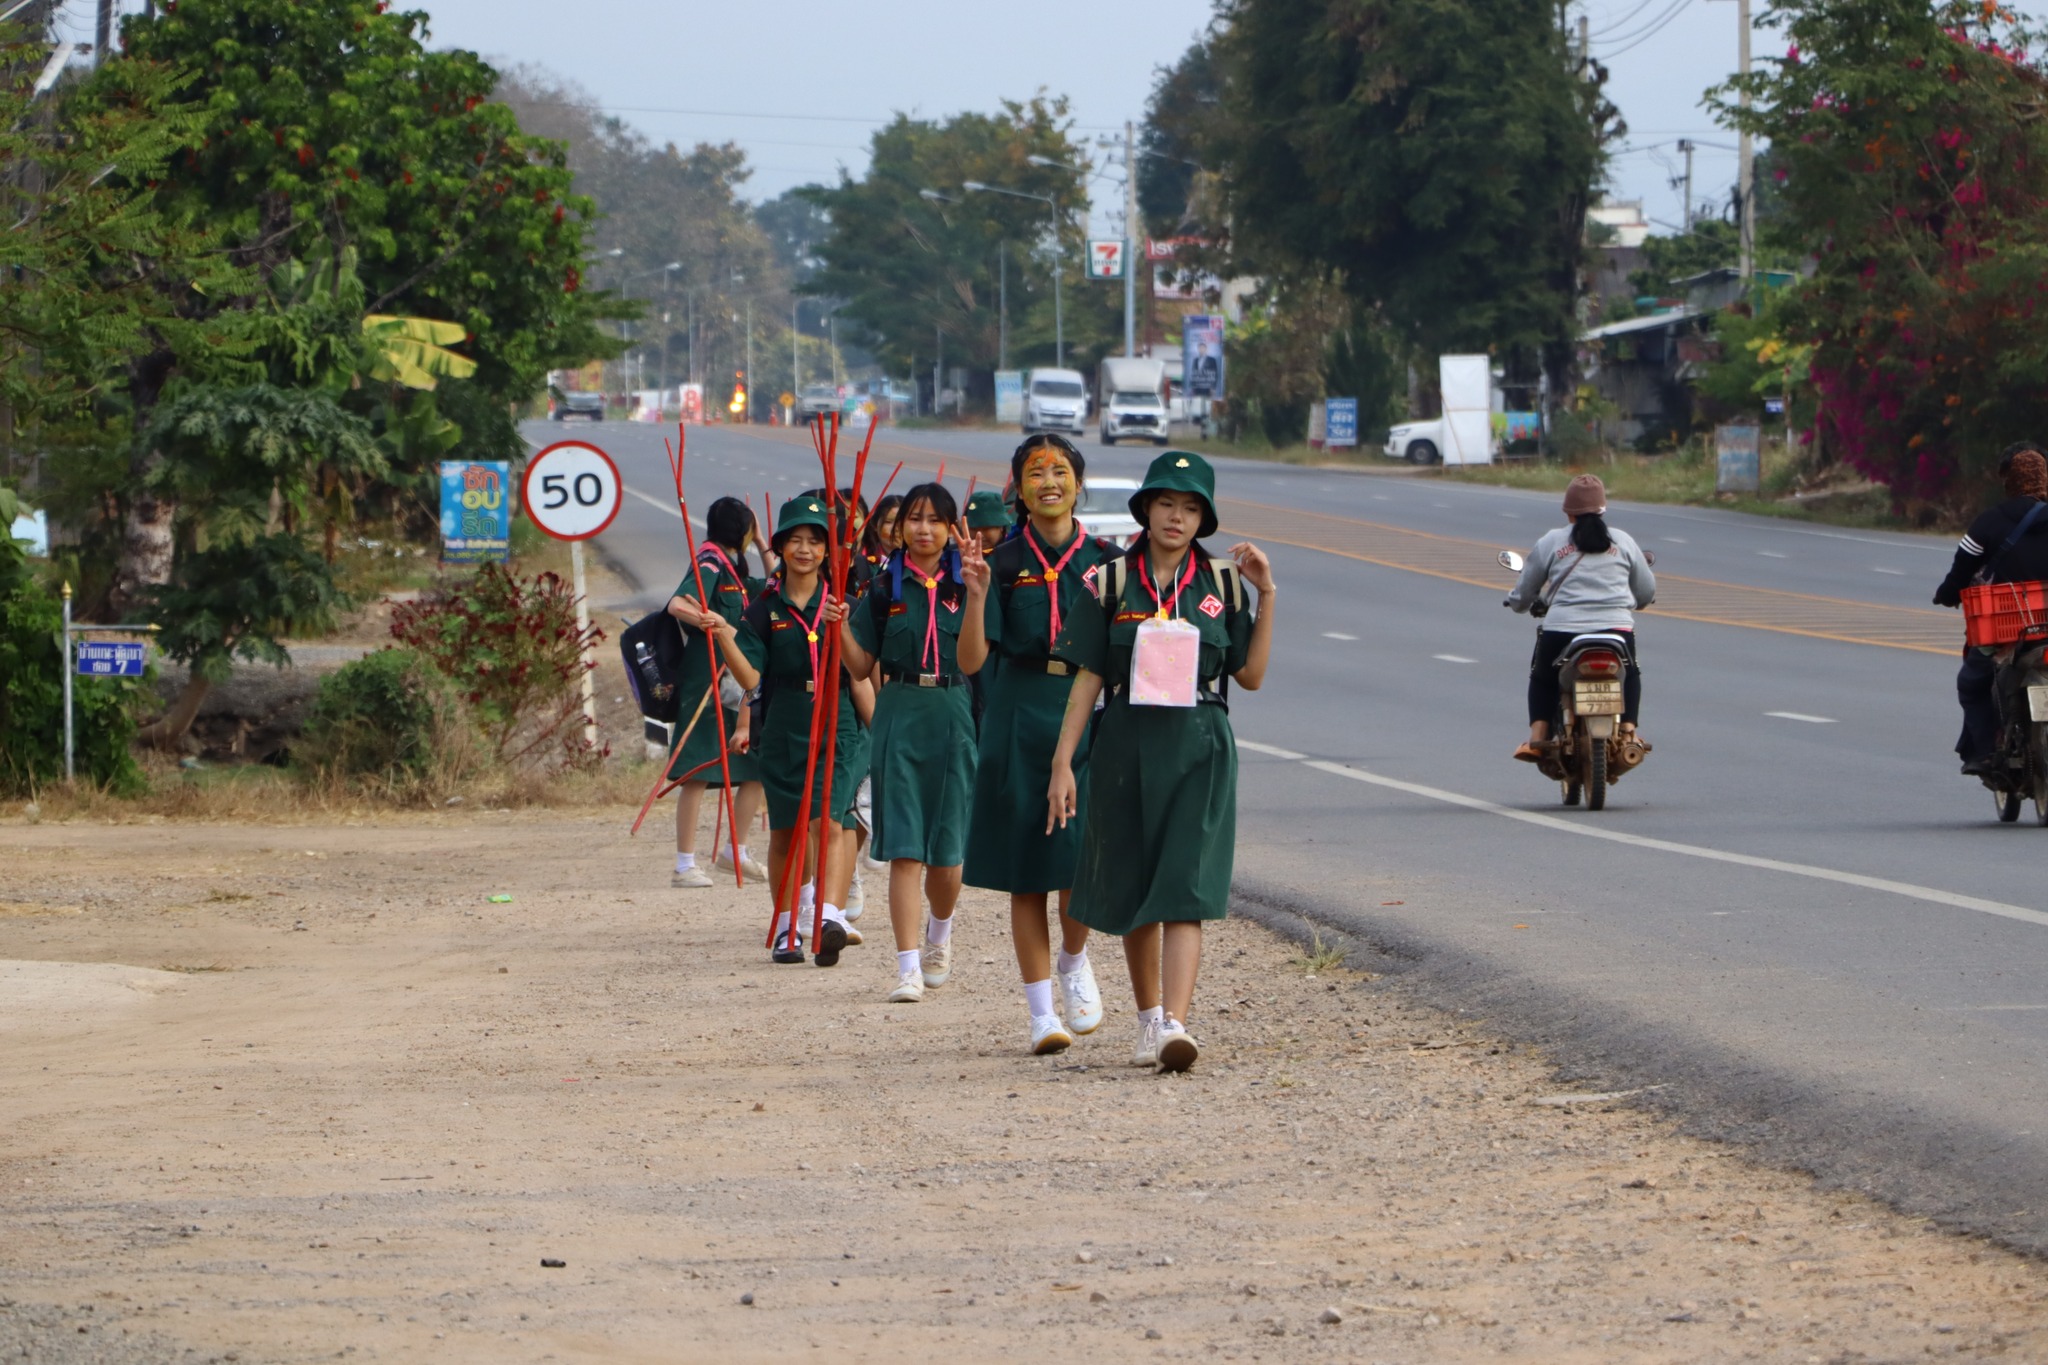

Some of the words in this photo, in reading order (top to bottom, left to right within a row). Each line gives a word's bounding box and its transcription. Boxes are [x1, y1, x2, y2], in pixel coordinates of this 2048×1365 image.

[1096, 244, 1118, 276] 7
[462, 464, 500, 491] ซัก
[541, 472, 603, 510] 50
[461, 490, 501, 510] อบ
[461, 510, 499, 537] รีด
[92, 661, 112, 673] ซอย
[115, 660, 128, 675] 7
